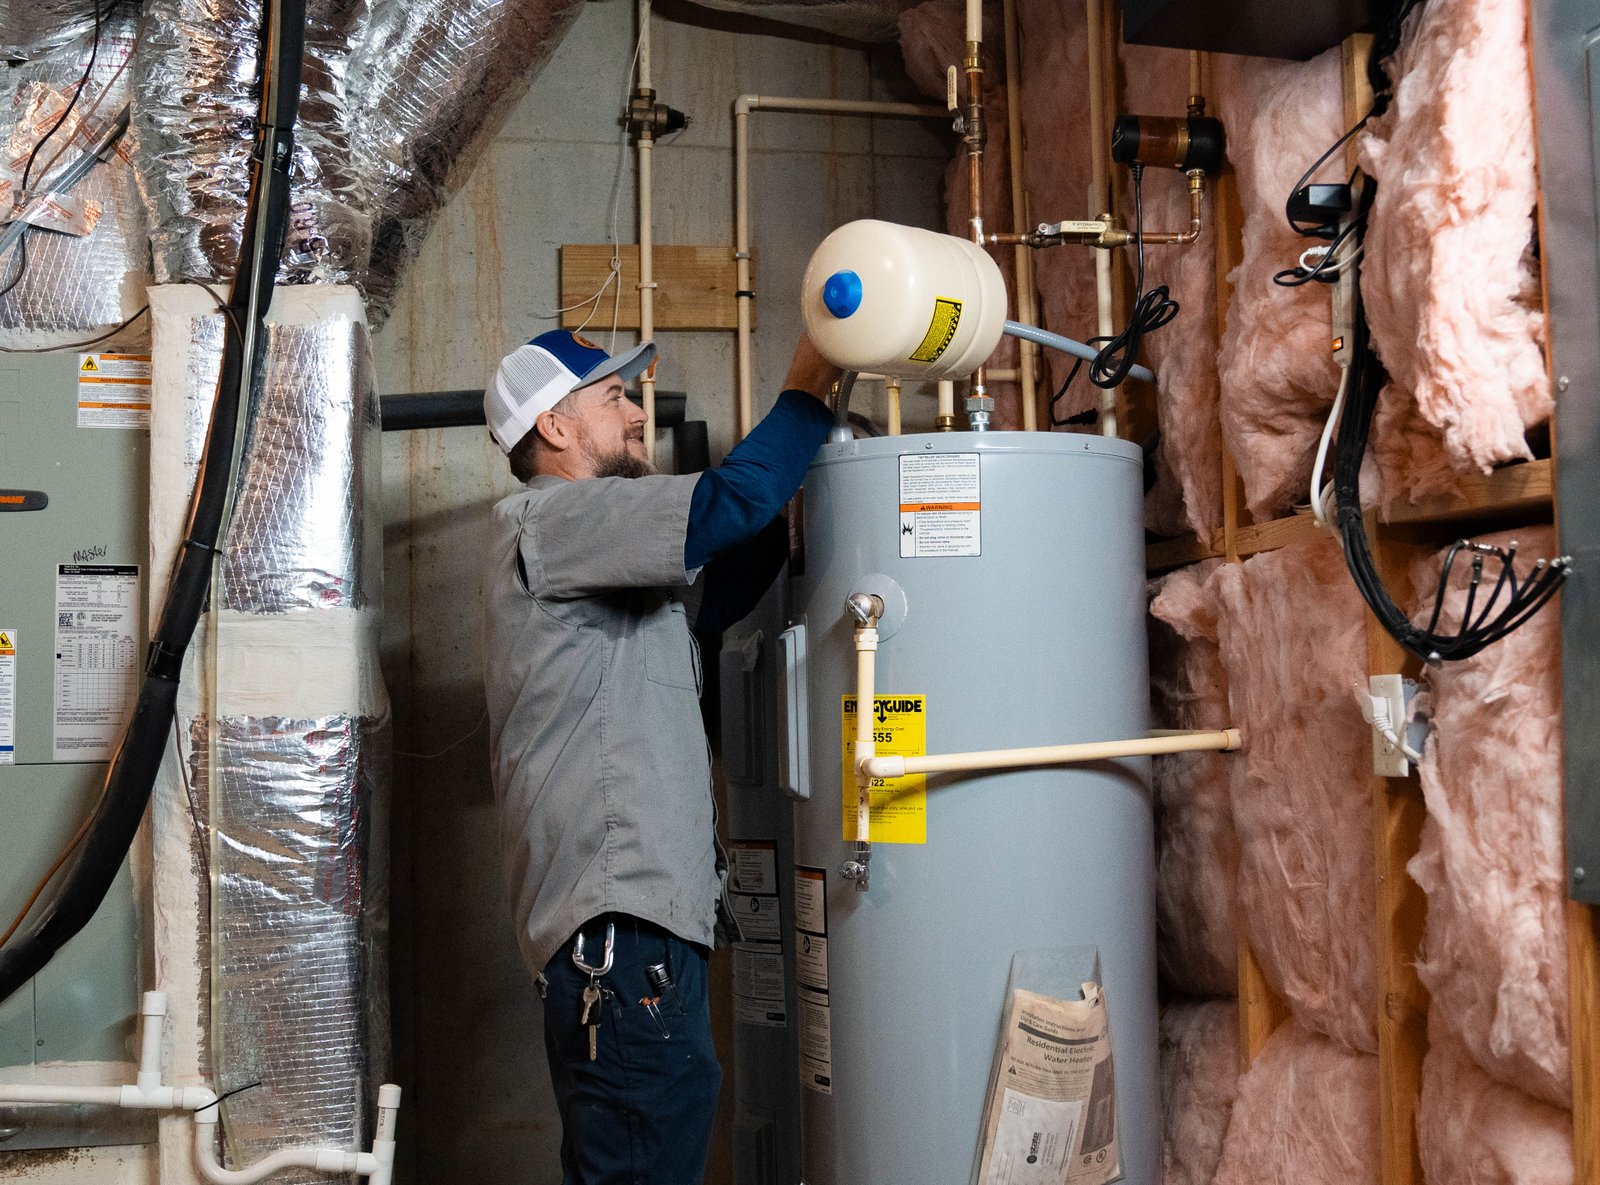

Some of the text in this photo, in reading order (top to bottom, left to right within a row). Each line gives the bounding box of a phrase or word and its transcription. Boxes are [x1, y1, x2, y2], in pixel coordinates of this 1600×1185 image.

[844, 700, 922, 713] ENGYGUIDE
[1044, 1025, 1058, 1034] Guide
[1046, 1018, 1075, 1032] Instructions
[1027, 1036, 1094, 1054] Residential Electric
[1044, 1053, 1066, 1063] Water
[1030, 1132, 1040, 1154] state
